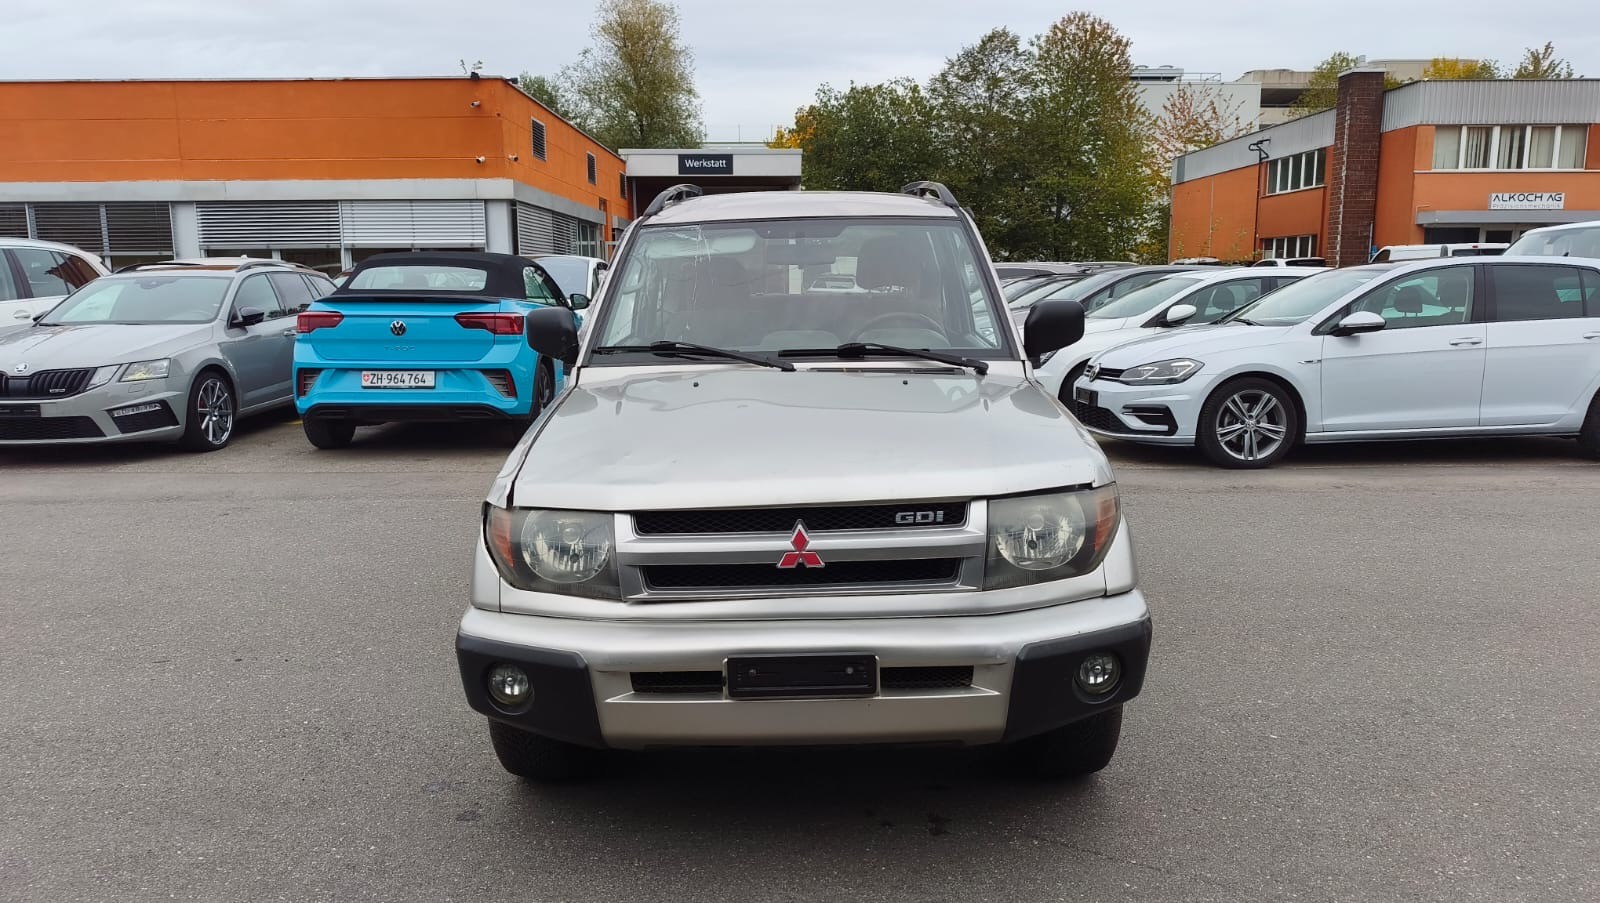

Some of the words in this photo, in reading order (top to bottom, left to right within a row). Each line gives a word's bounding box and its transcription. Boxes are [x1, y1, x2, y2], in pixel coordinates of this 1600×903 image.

[684, 158, 727, 168] Werkstatt
[1493, 193, 1543, 202] ALKOCH
[1546, 193, 1563, 202] AG
